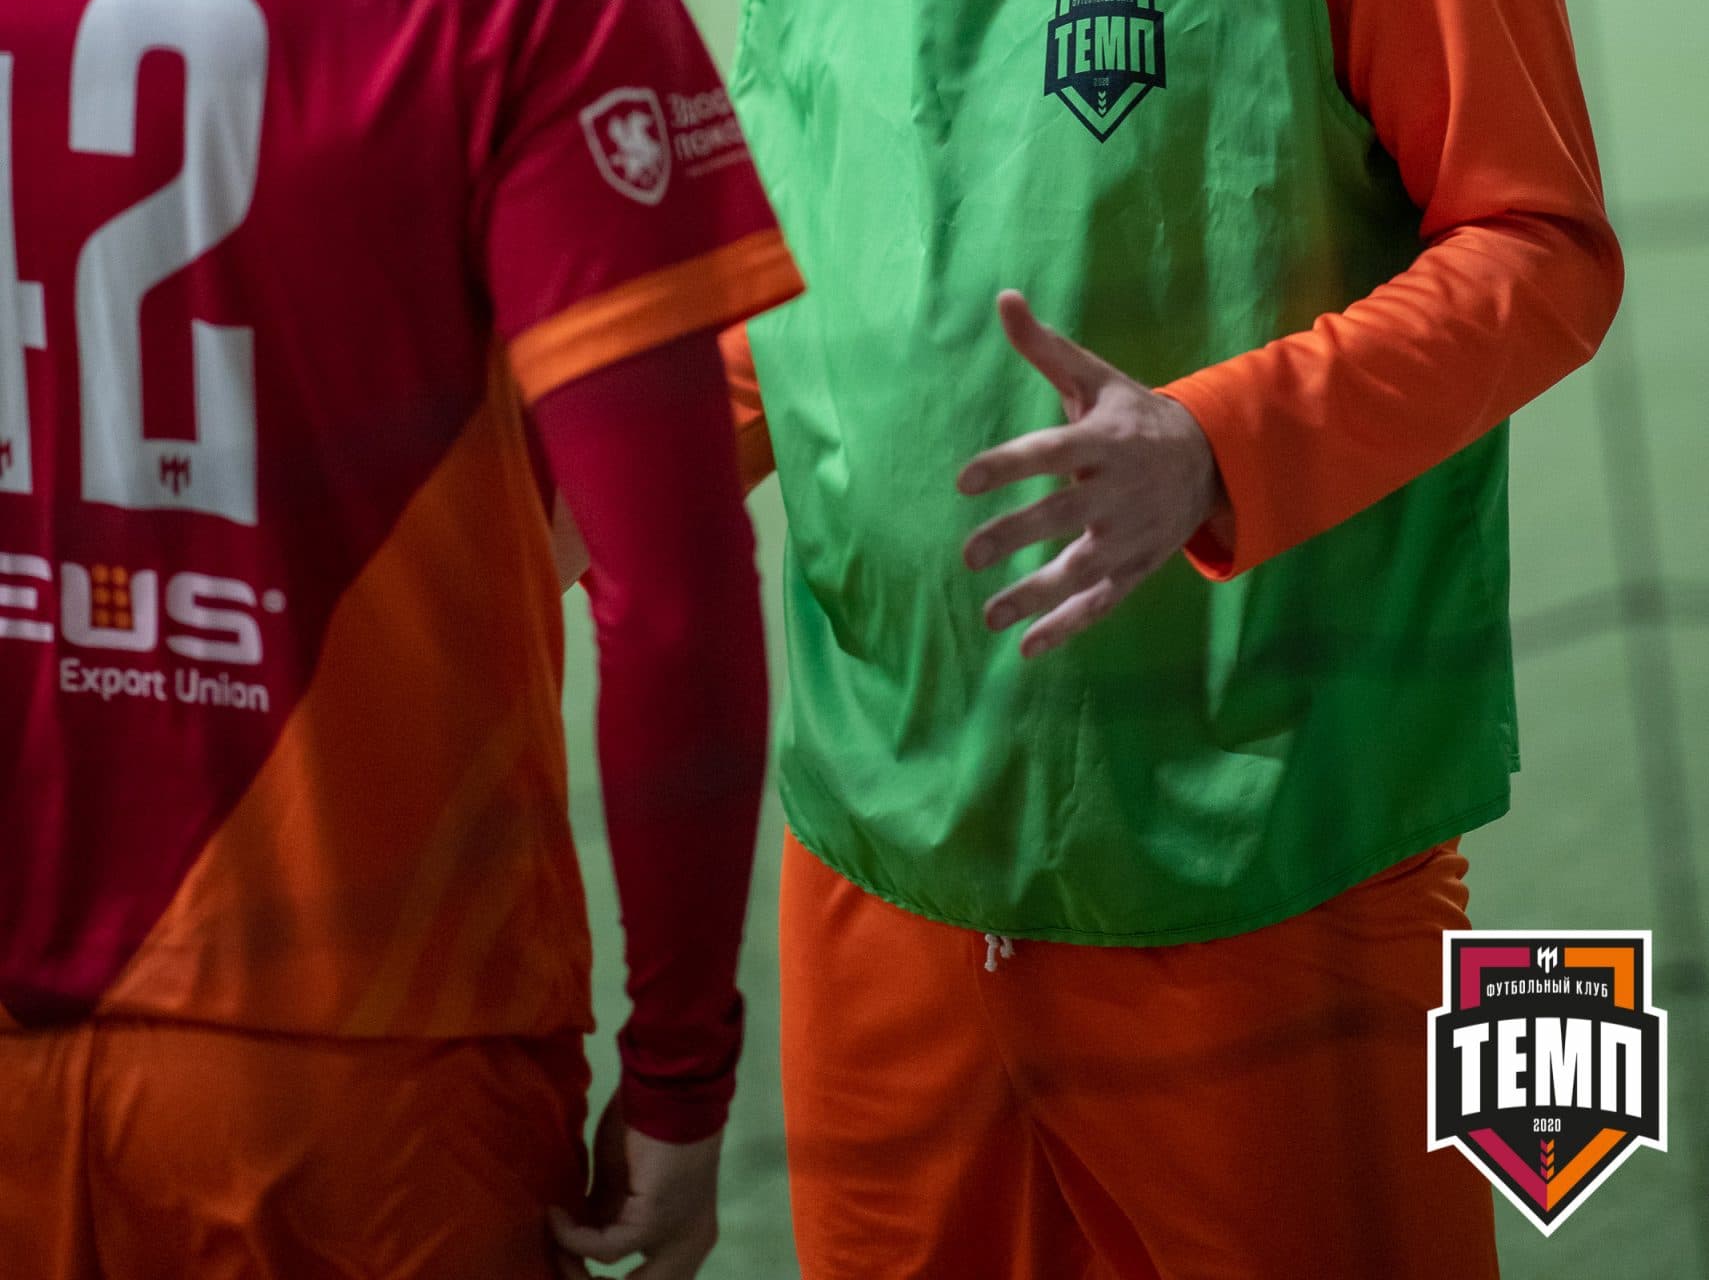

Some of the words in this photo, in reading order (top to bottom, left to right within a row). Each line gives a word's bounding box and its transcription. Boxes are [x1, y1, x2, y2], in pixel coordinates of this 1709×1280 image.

[1055, 15, 1156, 80] ТЕМП
[59, 658, 168, 701] Export
[175, 669, 270, 712] Union
